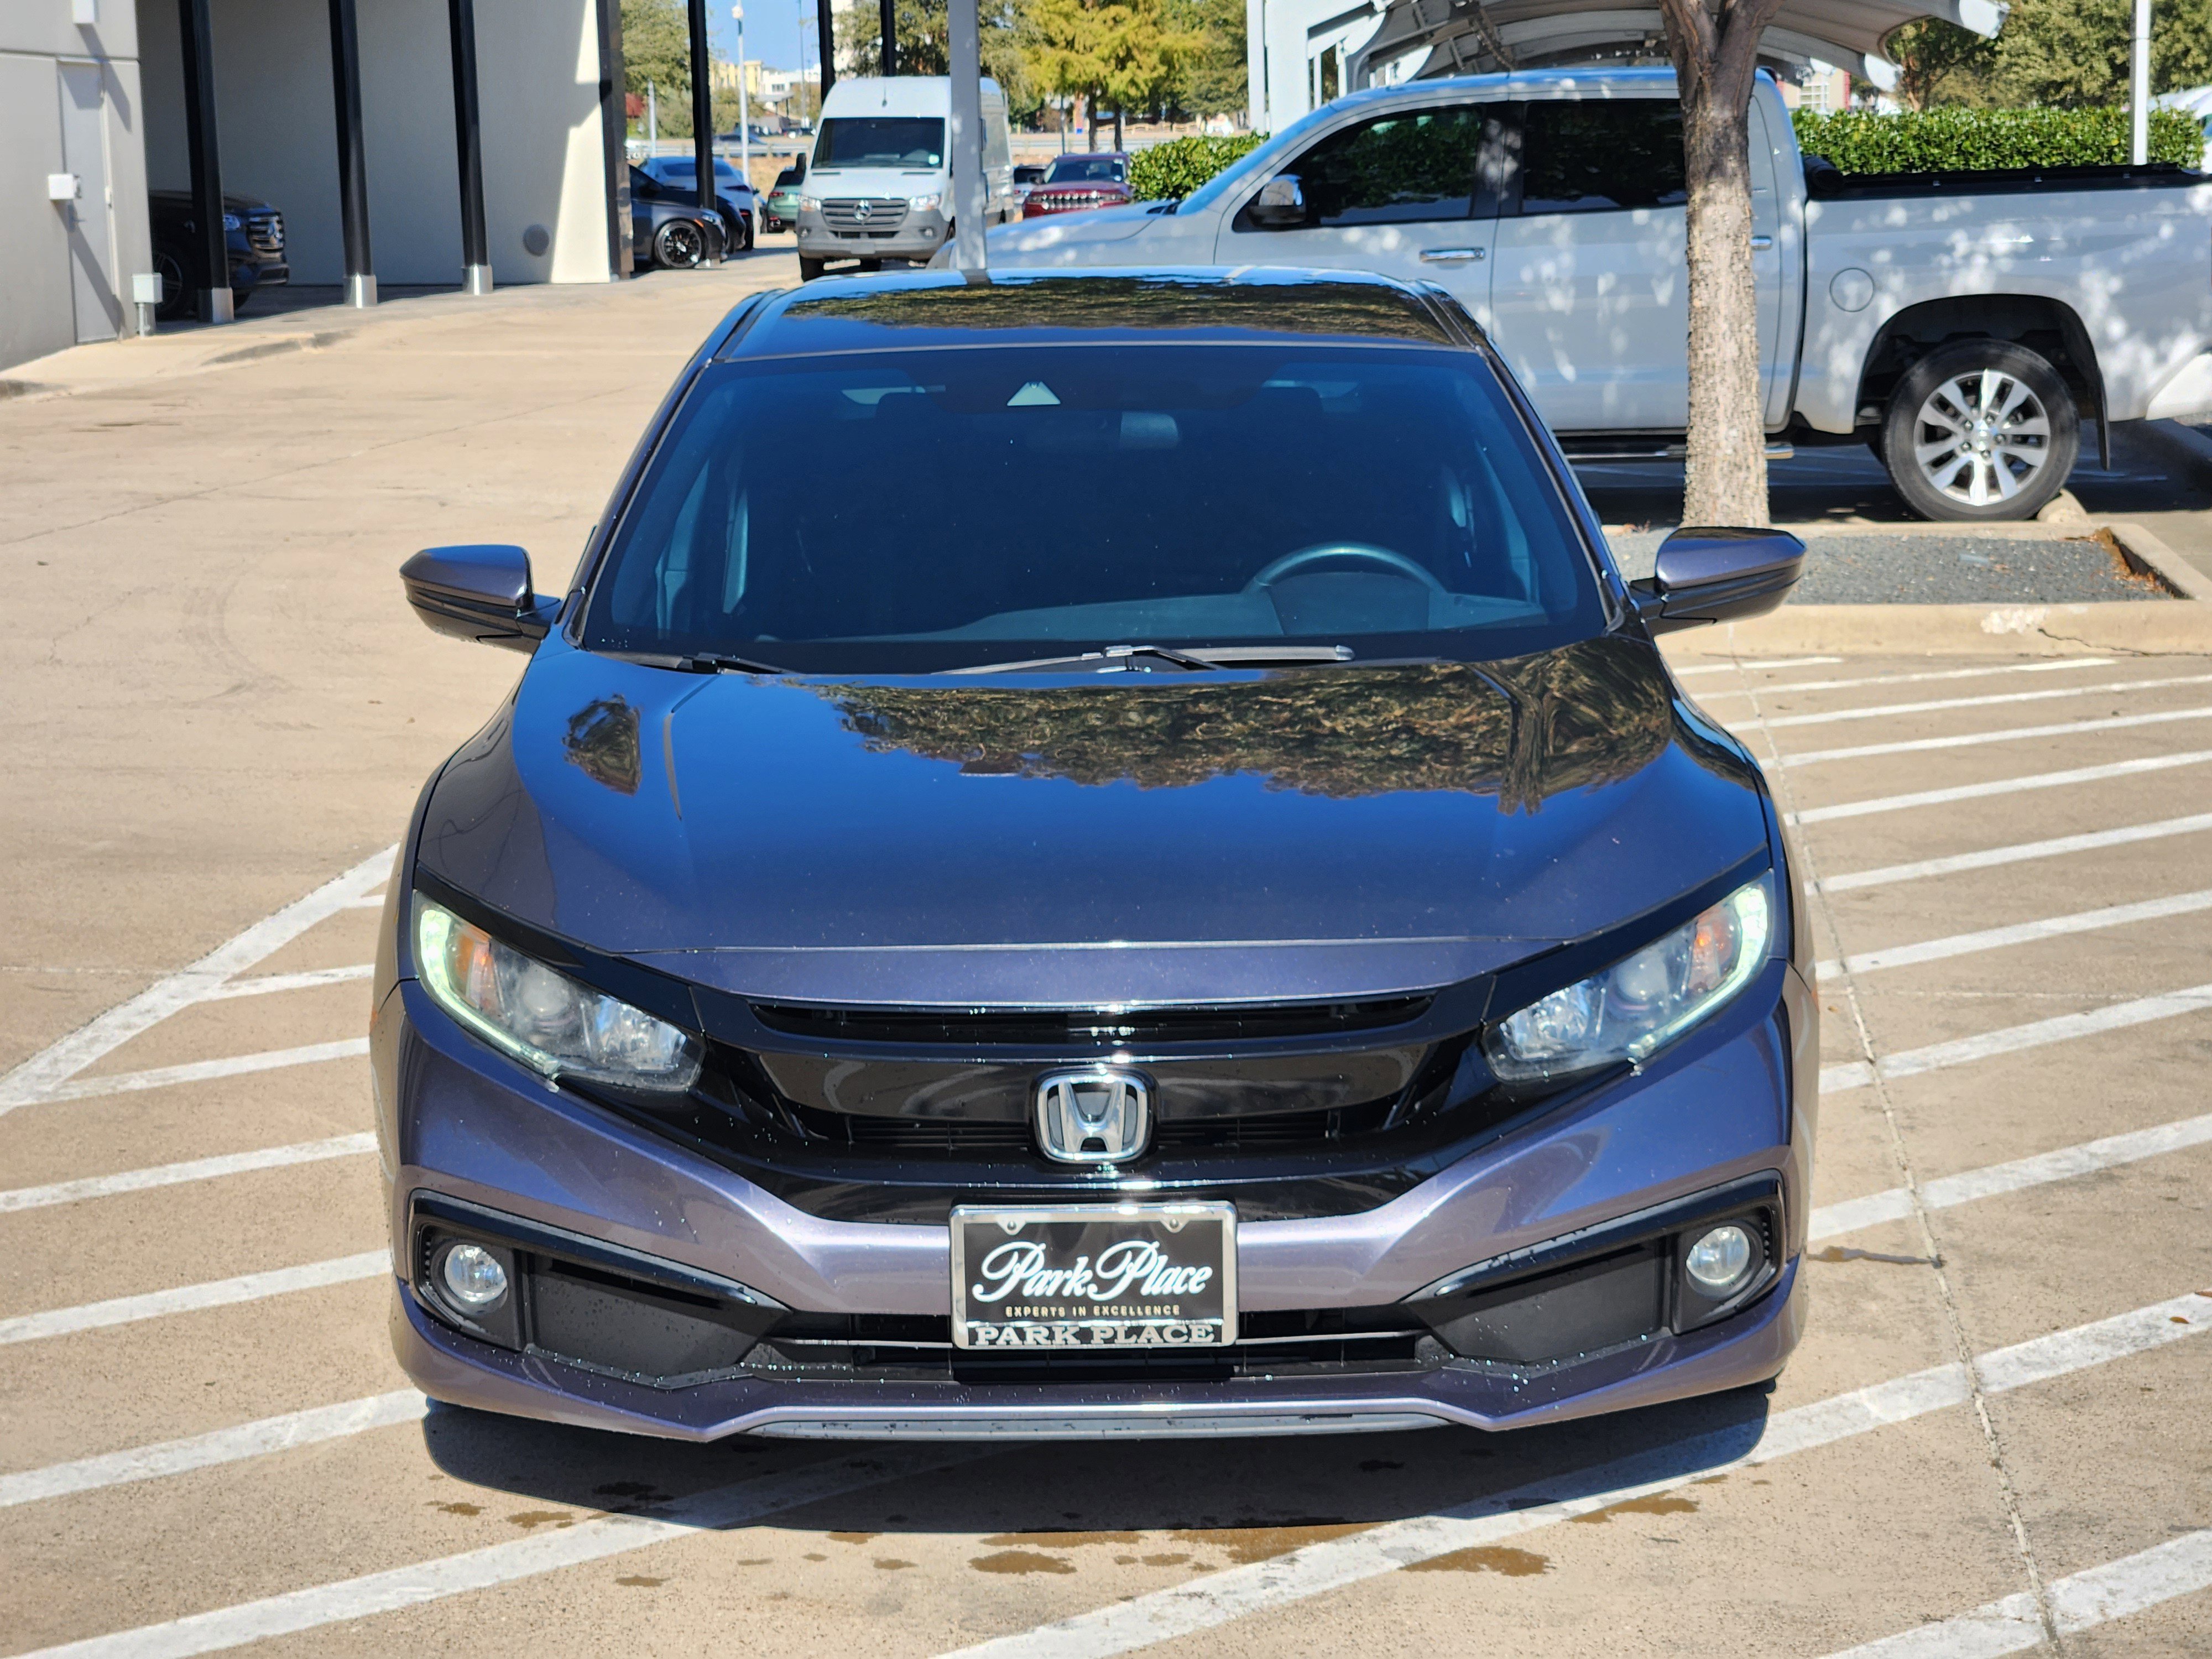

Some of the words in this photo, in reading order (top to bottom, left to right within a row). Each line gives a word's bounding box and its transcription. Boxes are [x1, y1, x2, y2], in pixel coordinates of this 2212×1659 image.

[972, 1240, 1093, 1302] Park
[1088, 1240, 1213, 1300] Place
[1005, 1306, 1066, 1317] EXPERTS
[1072, 1306, 1087, 1317] IN
[1093, 1305, 1180, 1317] EXCELLENCE
[975, 1327, 1080, 1345] PARK
[1090, 1324, 1214, 1344] PLACE
